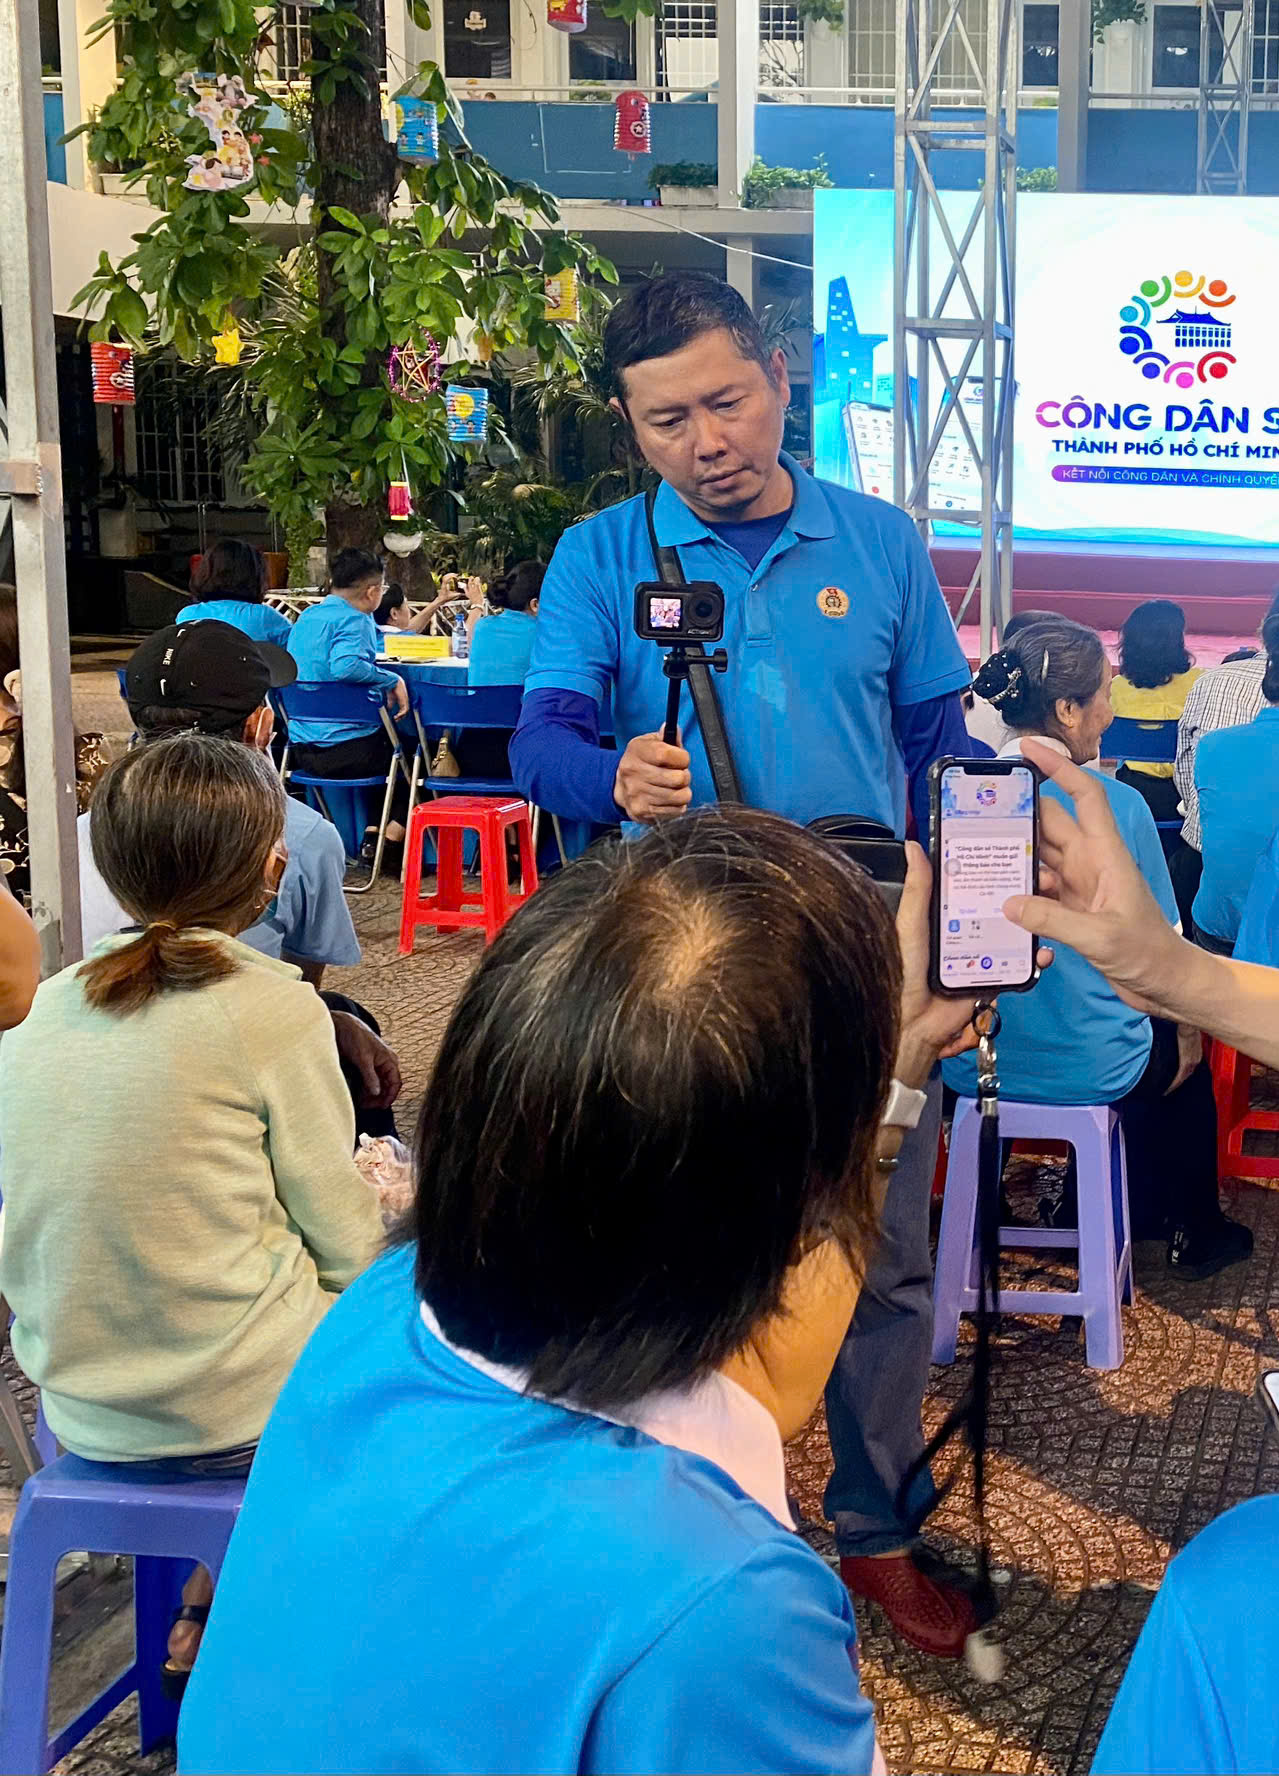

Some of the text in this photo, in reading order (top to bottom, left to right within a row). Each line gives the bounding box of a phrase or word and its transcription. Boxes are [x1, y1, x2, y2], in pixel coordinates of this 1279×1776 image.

[1035, 395, 1152, 431] CÔNG
[1164, 398, 1250, 434] DÂN
[1051, 437, 1118, 454] THÀNH
[1124, 436, 1164, 456] PHỐ
[1169, 437, 1199, 457] HỒ
[1203, 441, 1240, 458] CHÍ
[1113, 469, 1148, 481] CÔNG
[162, 648, 174, 666] NIKE
